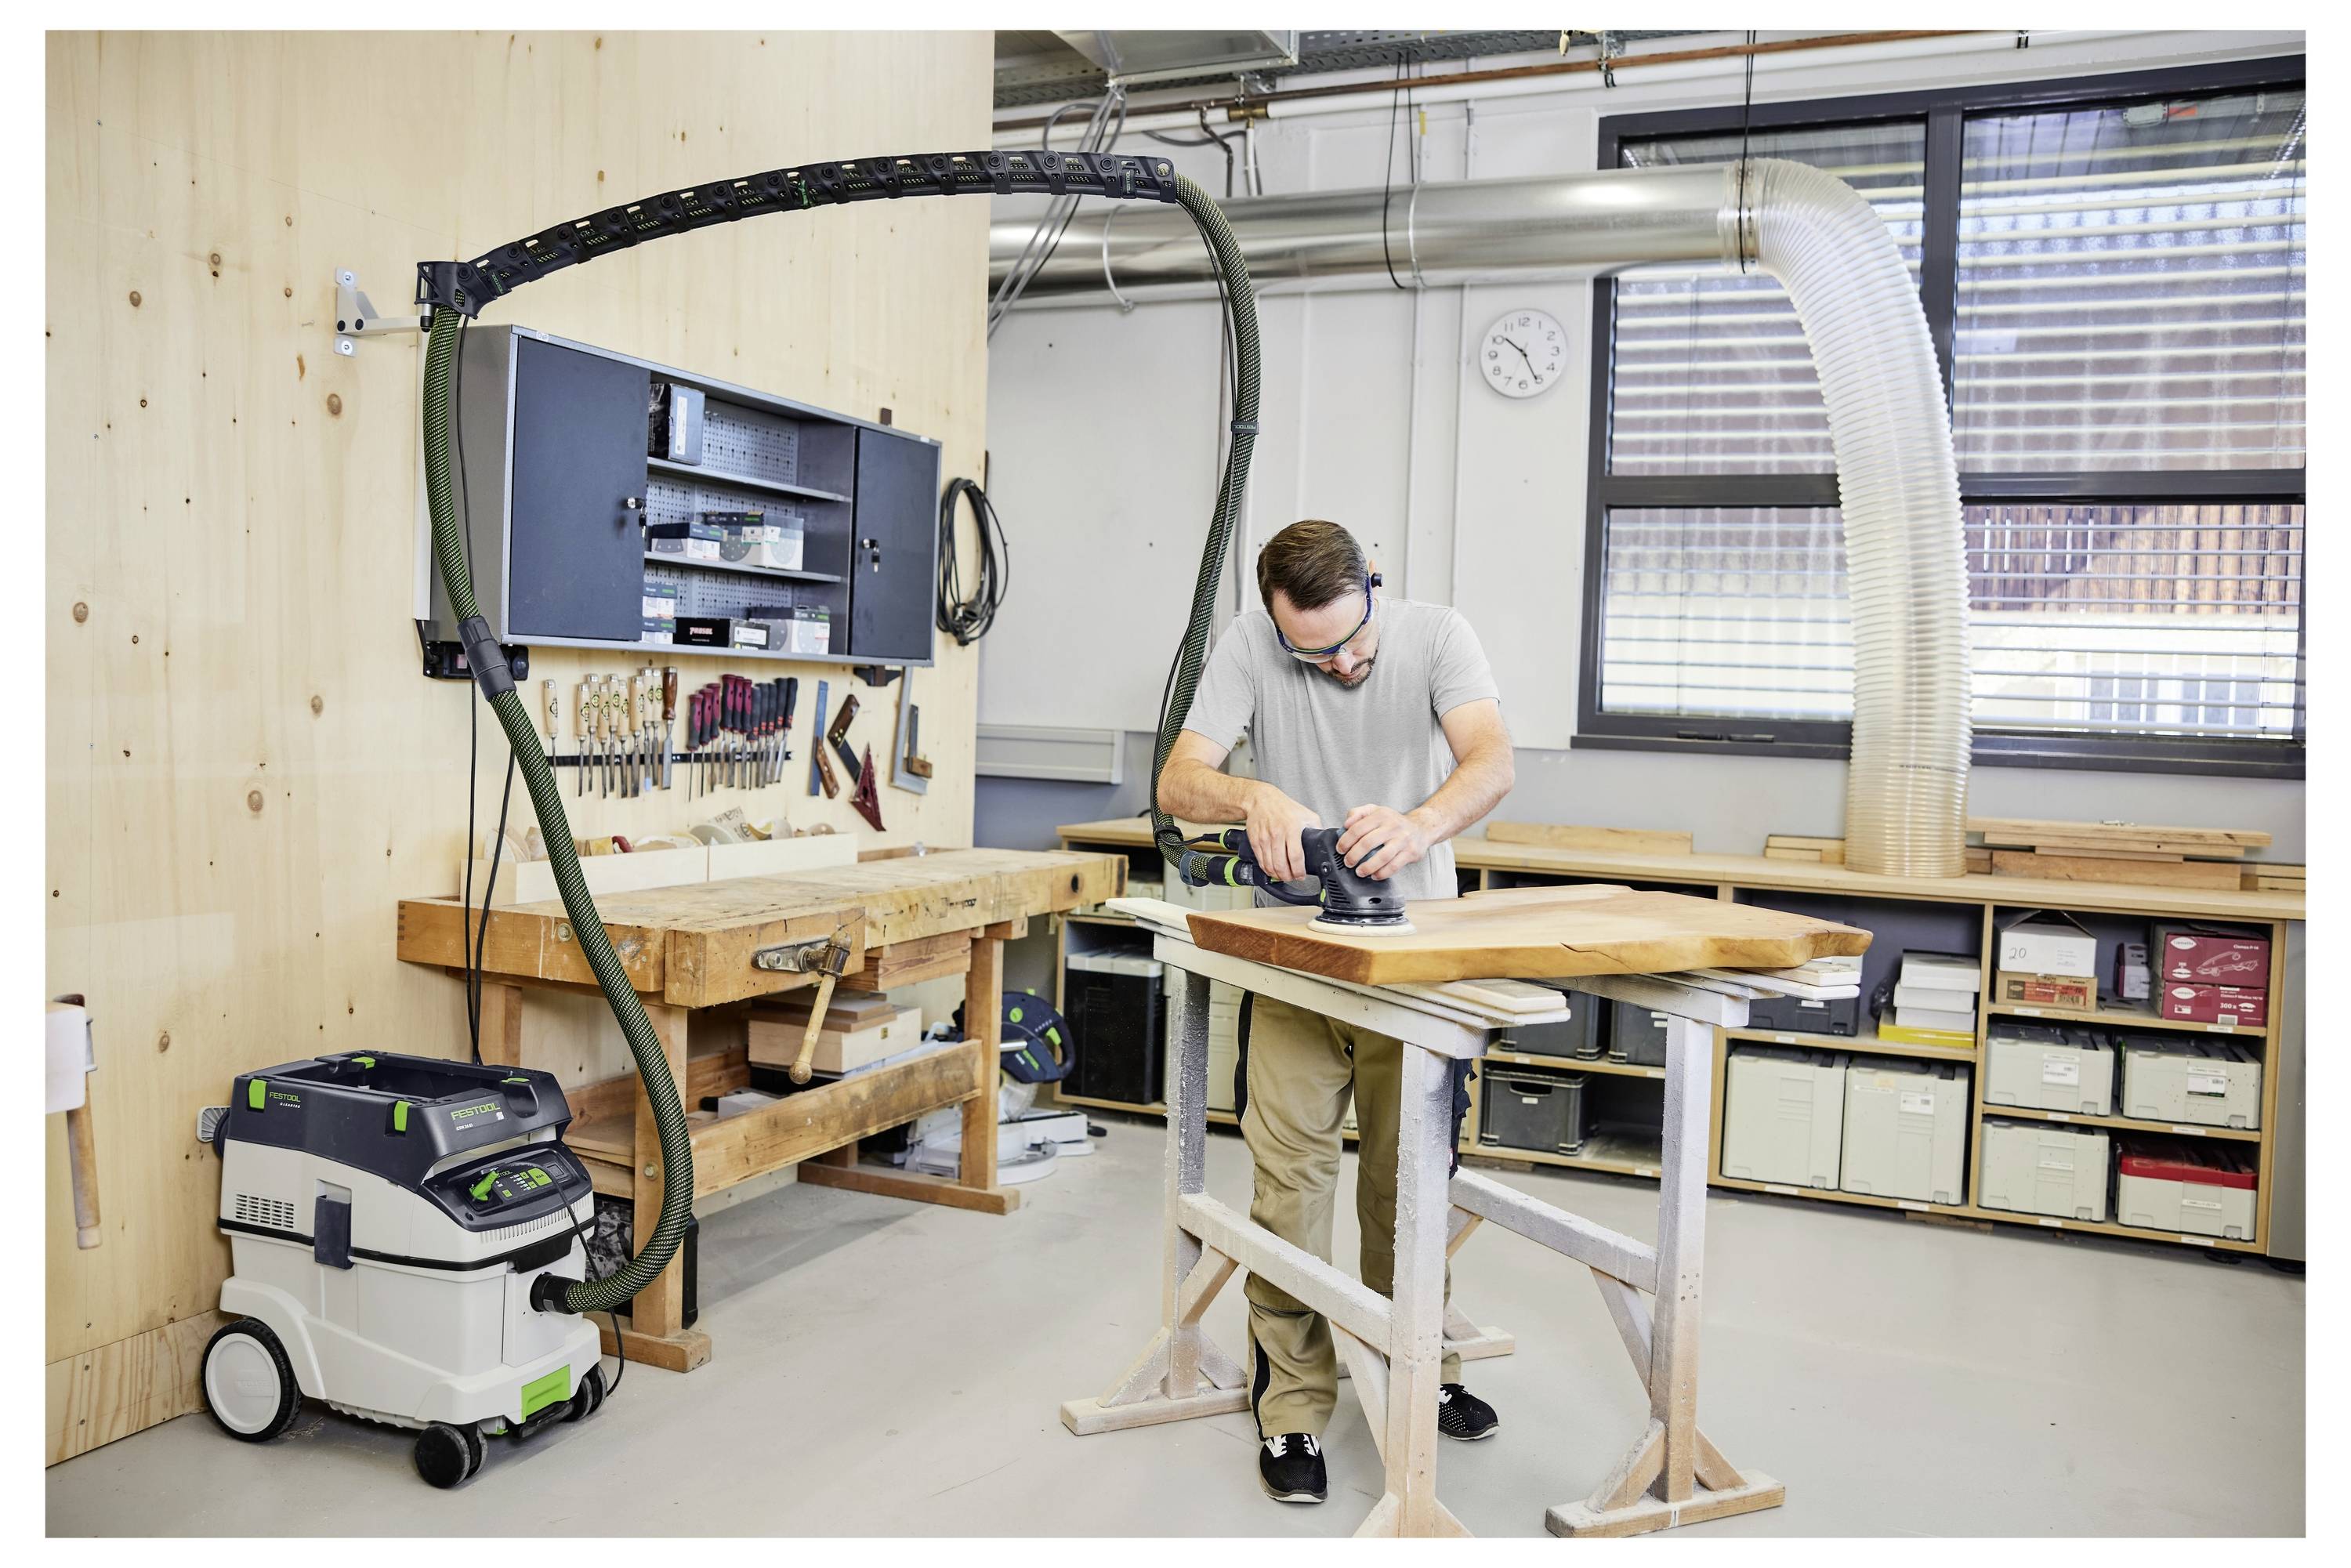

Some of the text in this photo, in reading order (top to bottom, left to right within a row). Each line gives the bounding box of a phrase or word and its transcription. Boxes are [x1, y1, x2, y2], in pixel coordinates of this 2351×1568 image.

[1504, 322, 1513, 331] 11
[1518, 317, 1530, 327] 12
[1492, 335, 1505, 345] 10
[1547, 331, 1556, 341] 2
[1488, 350, 1498, 360] 9
[1551, 346, 1559, 357] 3
[1493, 366, 1501, 375] 8
[1546, 363, 1555, 371] 4
[1504, 376, 1512, 386] 7
[1518, 380, 1528, 389] 6
[2009, 947, 2027, 960] 20
[269, 1092, 301, 1103] FESTOOL
[451, 1103, 501, 1121] FESTOOL
